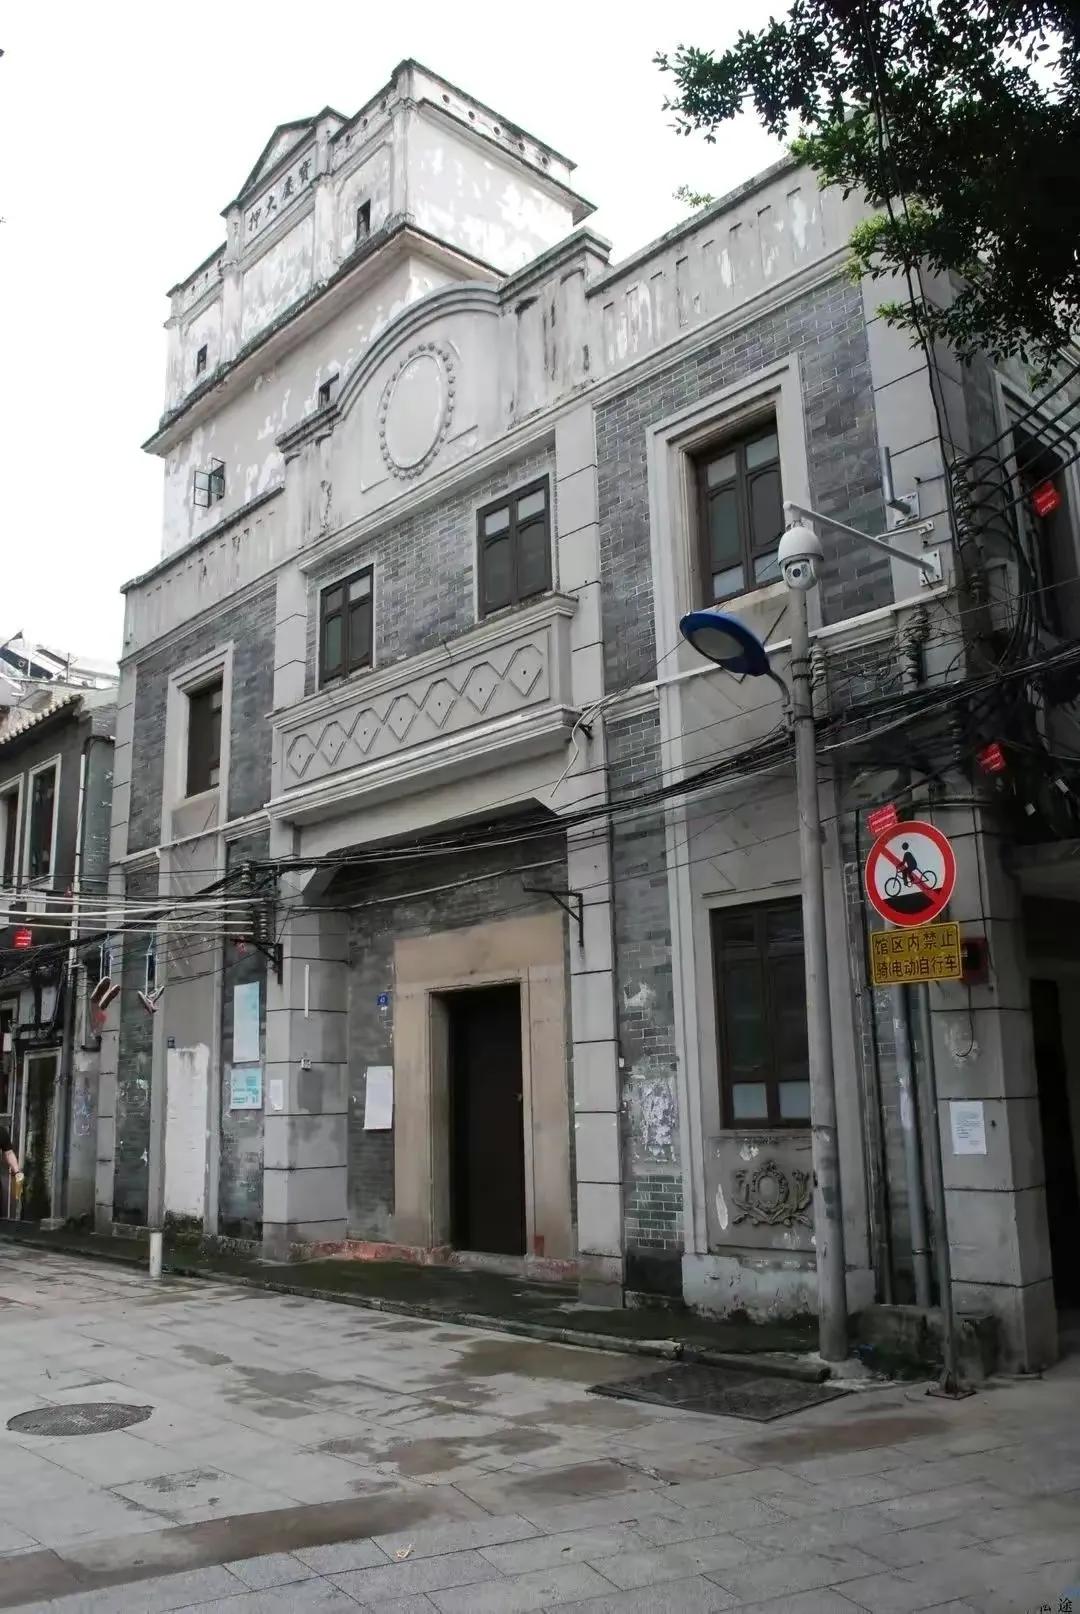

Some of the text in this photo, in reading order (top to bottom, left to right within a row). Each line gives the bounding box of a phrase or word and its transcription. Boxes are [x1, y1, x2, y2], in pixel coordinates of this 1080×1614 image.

[875, 930, 955, 954] 馆区内禁止
